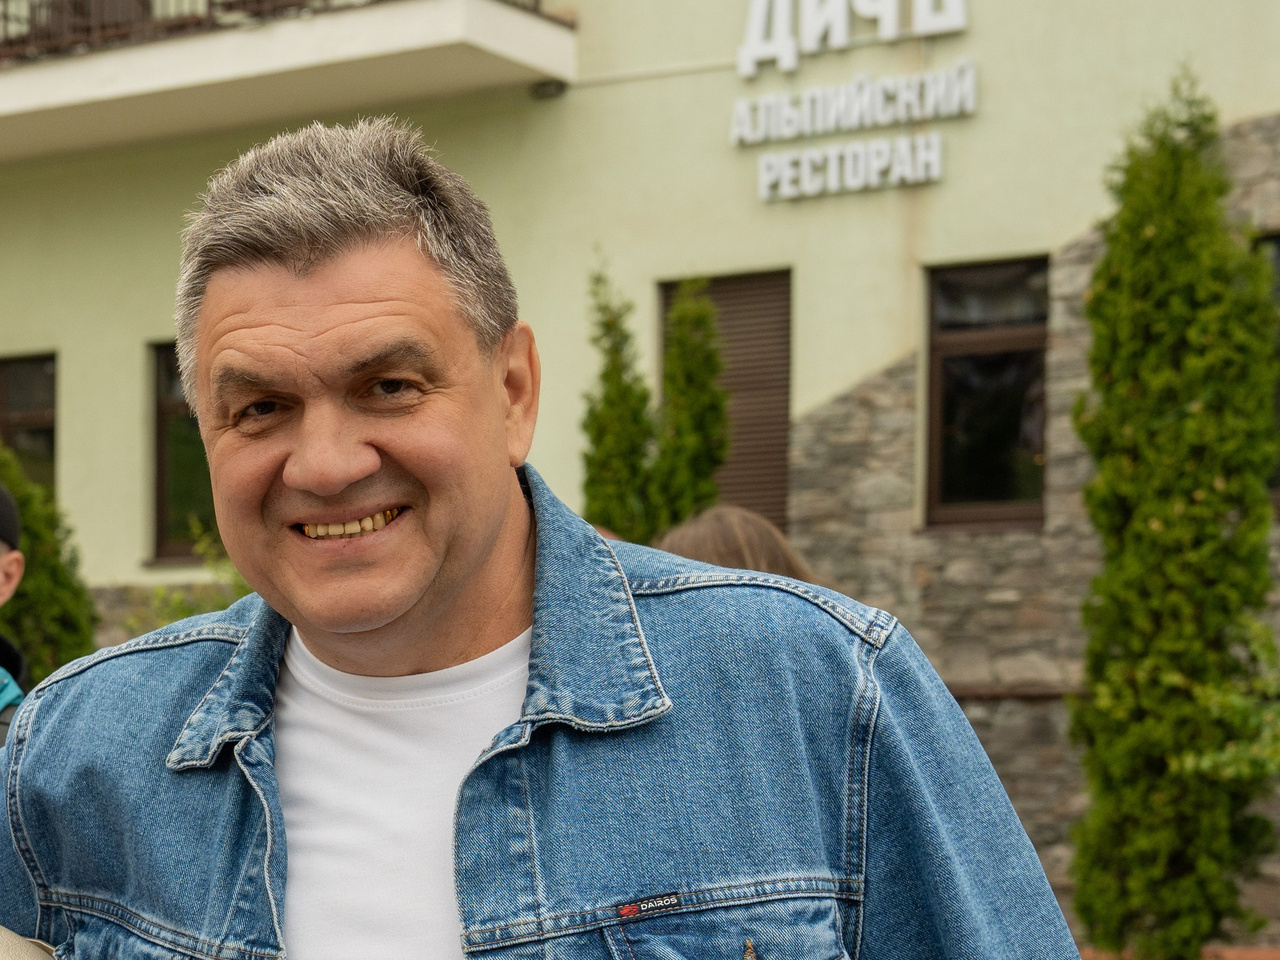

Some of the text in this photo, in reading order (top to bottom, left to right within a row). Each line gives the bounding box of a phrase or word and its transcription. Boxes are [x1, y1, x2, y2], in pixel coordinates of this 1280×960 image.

[730, 57, 976, 146] АЛЬПИЙСКИЙ
[757, 132, 941, 200] РЕСТОРАН
[640, 897, 678, 910] DAIROS
